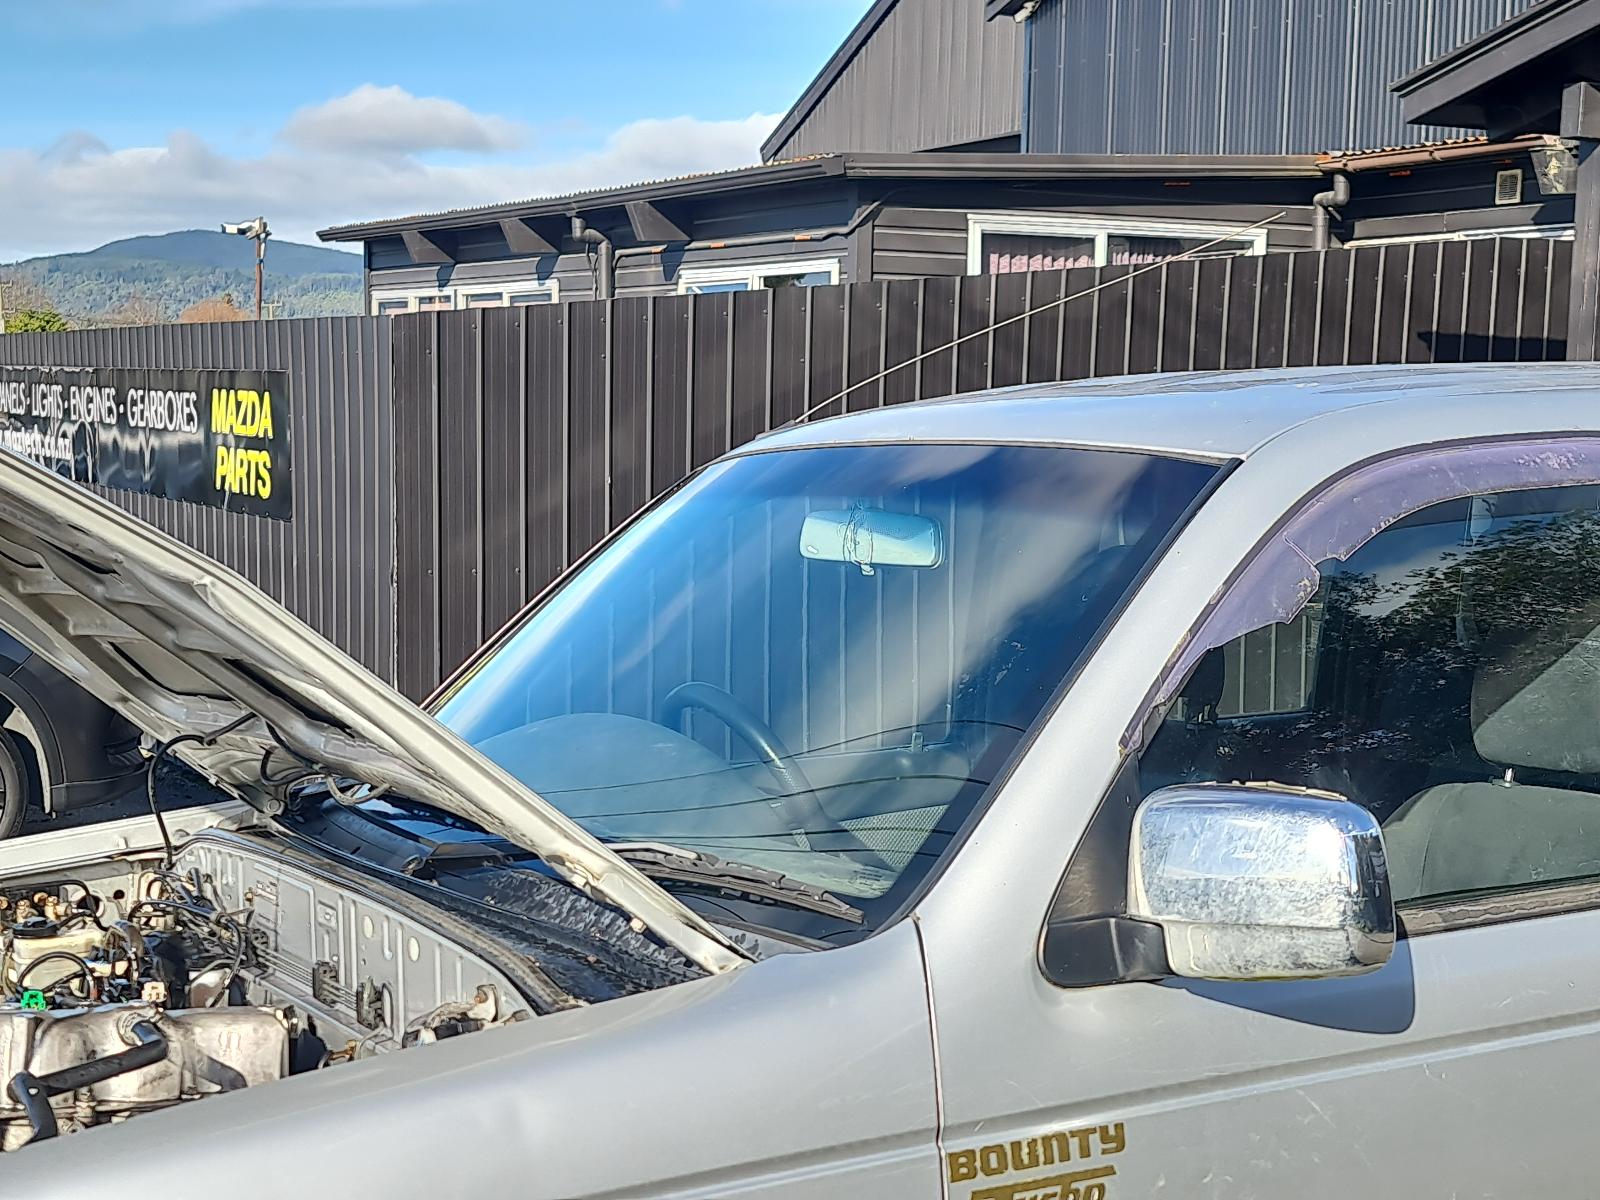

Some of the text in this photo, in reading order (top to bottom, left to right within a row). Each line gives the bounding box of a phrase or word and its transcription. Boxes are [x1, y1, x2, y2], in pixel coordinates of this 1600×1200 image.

[0, 380, 198, 434] ANELS LIGHTS ENGINES GEARBOXES
[211, 387, 273, 439] MAZDA
[215, 445, 272, 500] PARTS
[949, 1121, 1126, 1184] BOUNTY
